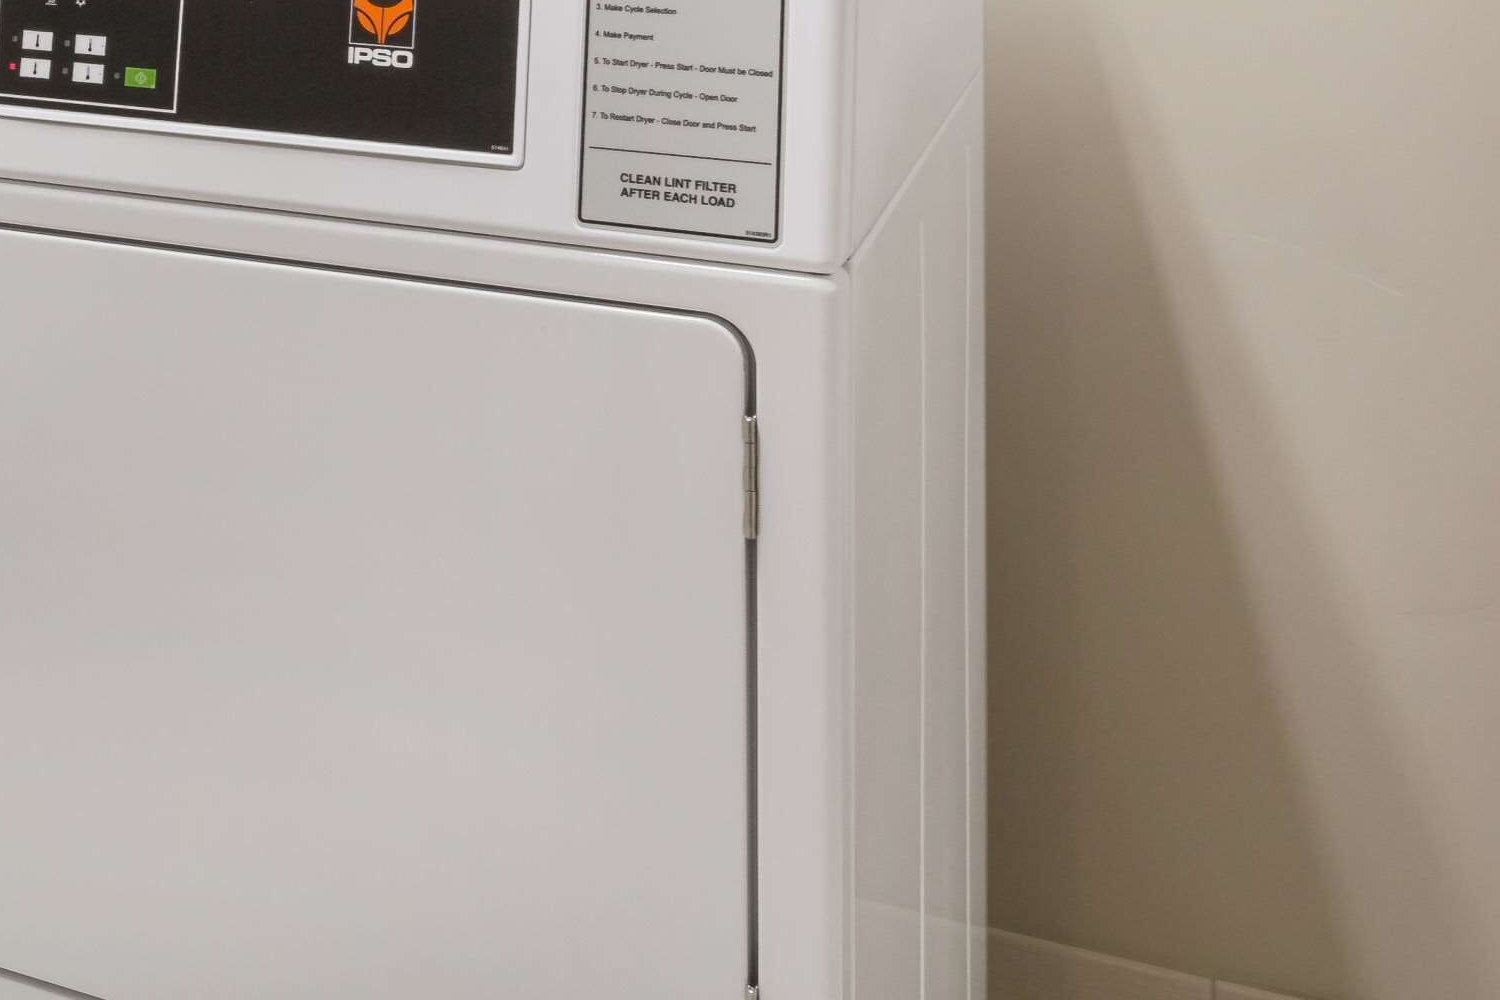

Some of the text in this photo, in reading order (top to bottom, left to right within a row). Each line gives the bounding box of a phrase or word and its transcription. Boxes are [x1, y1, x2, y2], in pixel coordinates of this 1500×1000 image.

[625, 5, 643, 13] Cycle
[646, 6, 676, 15] Selection
[624, 32, 653, 41] Payment
[348, 46, 413, 68] IPSO
[612, 59, 628, 67] Start
[630, 60, 648, 68] Dryer
[655, 62, 674, 70] Press
[700, 65, 716, 73] Door
[718, 66, 735, 75] Must
[748, 69, 772, 77] Closed
[611, 86, 626, 95] Stop
[629, 87, 647, 96] Dryer
[649, 89, 671, 98] During
[674, 91, 692, 100] Cycle
[700, 93, 718, 102] Open
[601, 112, 608, 120] To
[610, 113, 635, 122] Restart
[636, 115, 655, 124] Dryer
[661, 118, 681, 126] Close
[702, 121, 715, 129] and
[717, 122, 737, 131] Press
[739, 124, 756, 132] Start
[620, 173, 736, 193] CLEAN LINT FILTER
[620, 188, 735, 208] AFTER EACH LOAD
